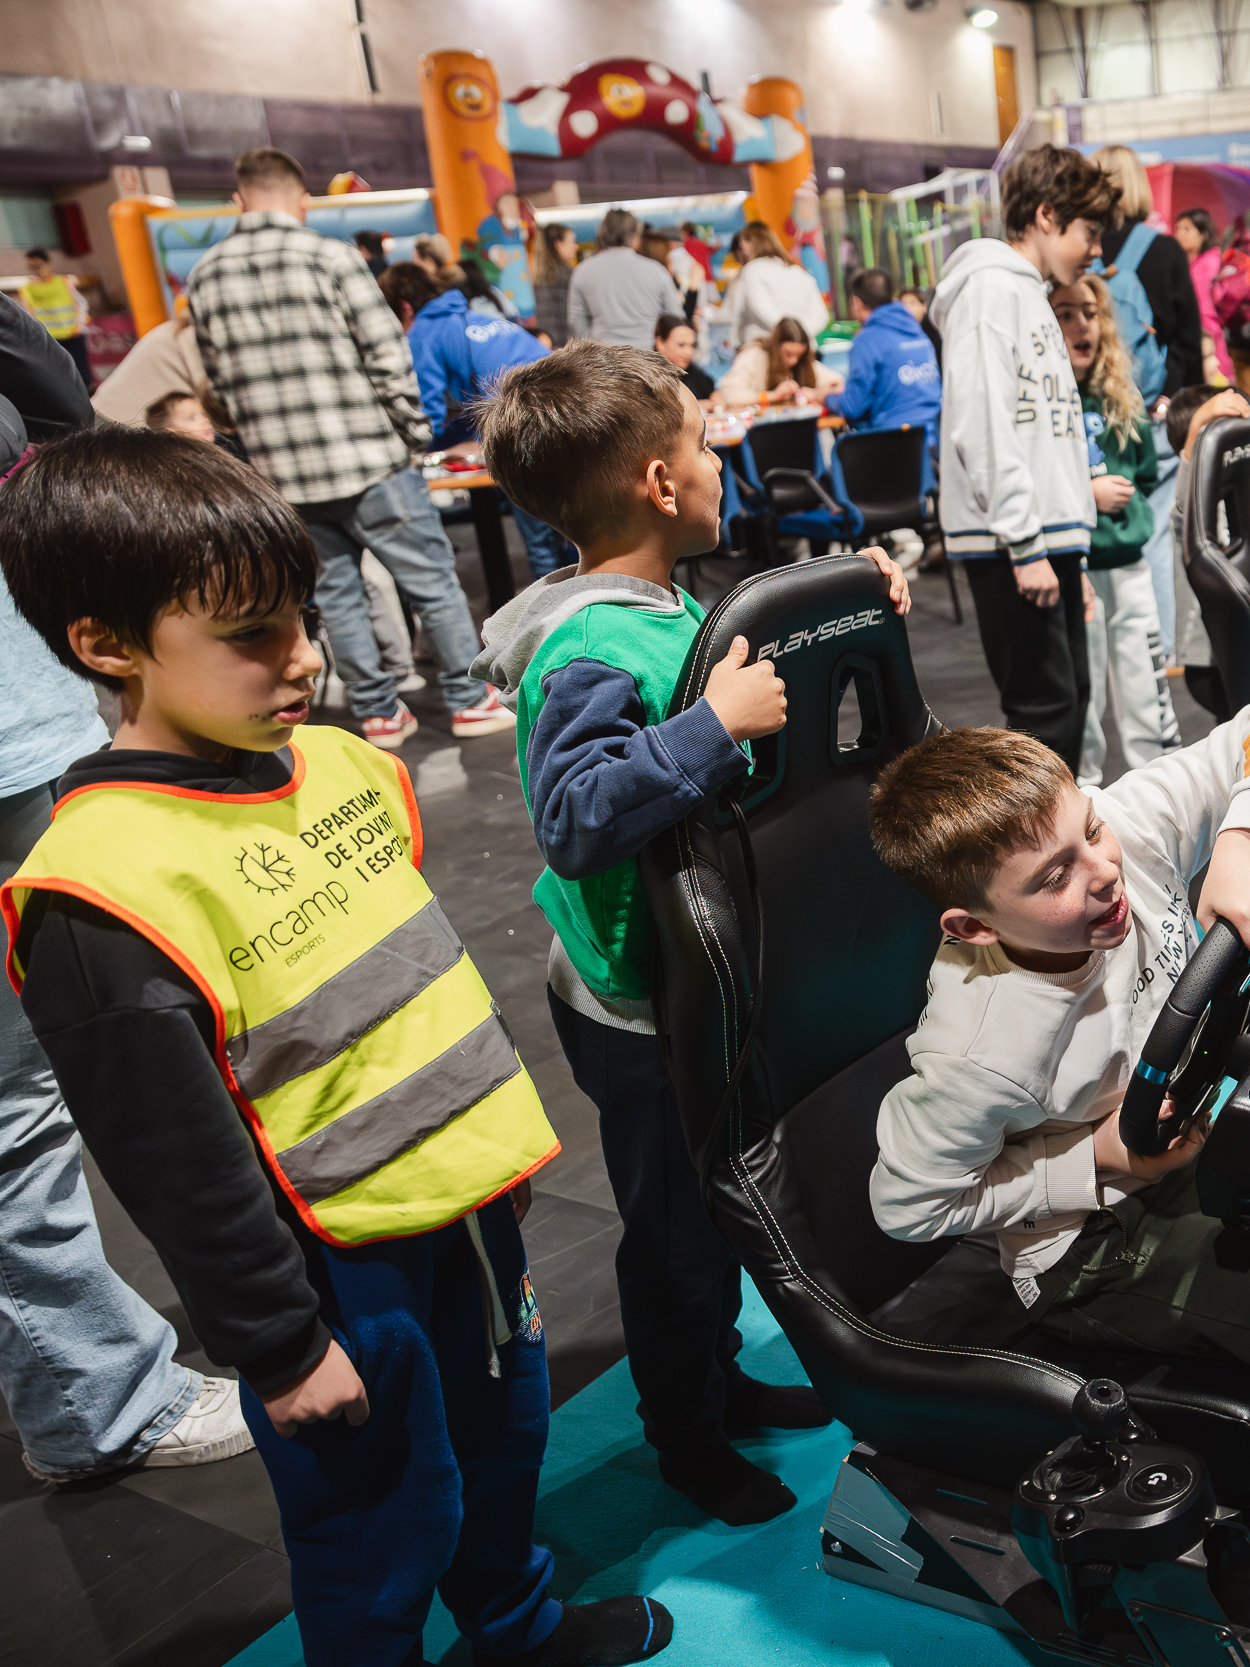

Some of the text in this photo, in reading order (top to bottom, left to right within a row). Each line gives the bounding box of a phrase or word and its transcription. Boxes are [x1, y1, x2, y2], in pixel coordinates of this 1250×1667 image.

[324, 842, 353, 869] DE
[355, 866, 370, 883] I
[228, 880, 349, 972] encamp
[285, 933, 327, 968] ESPORTS
